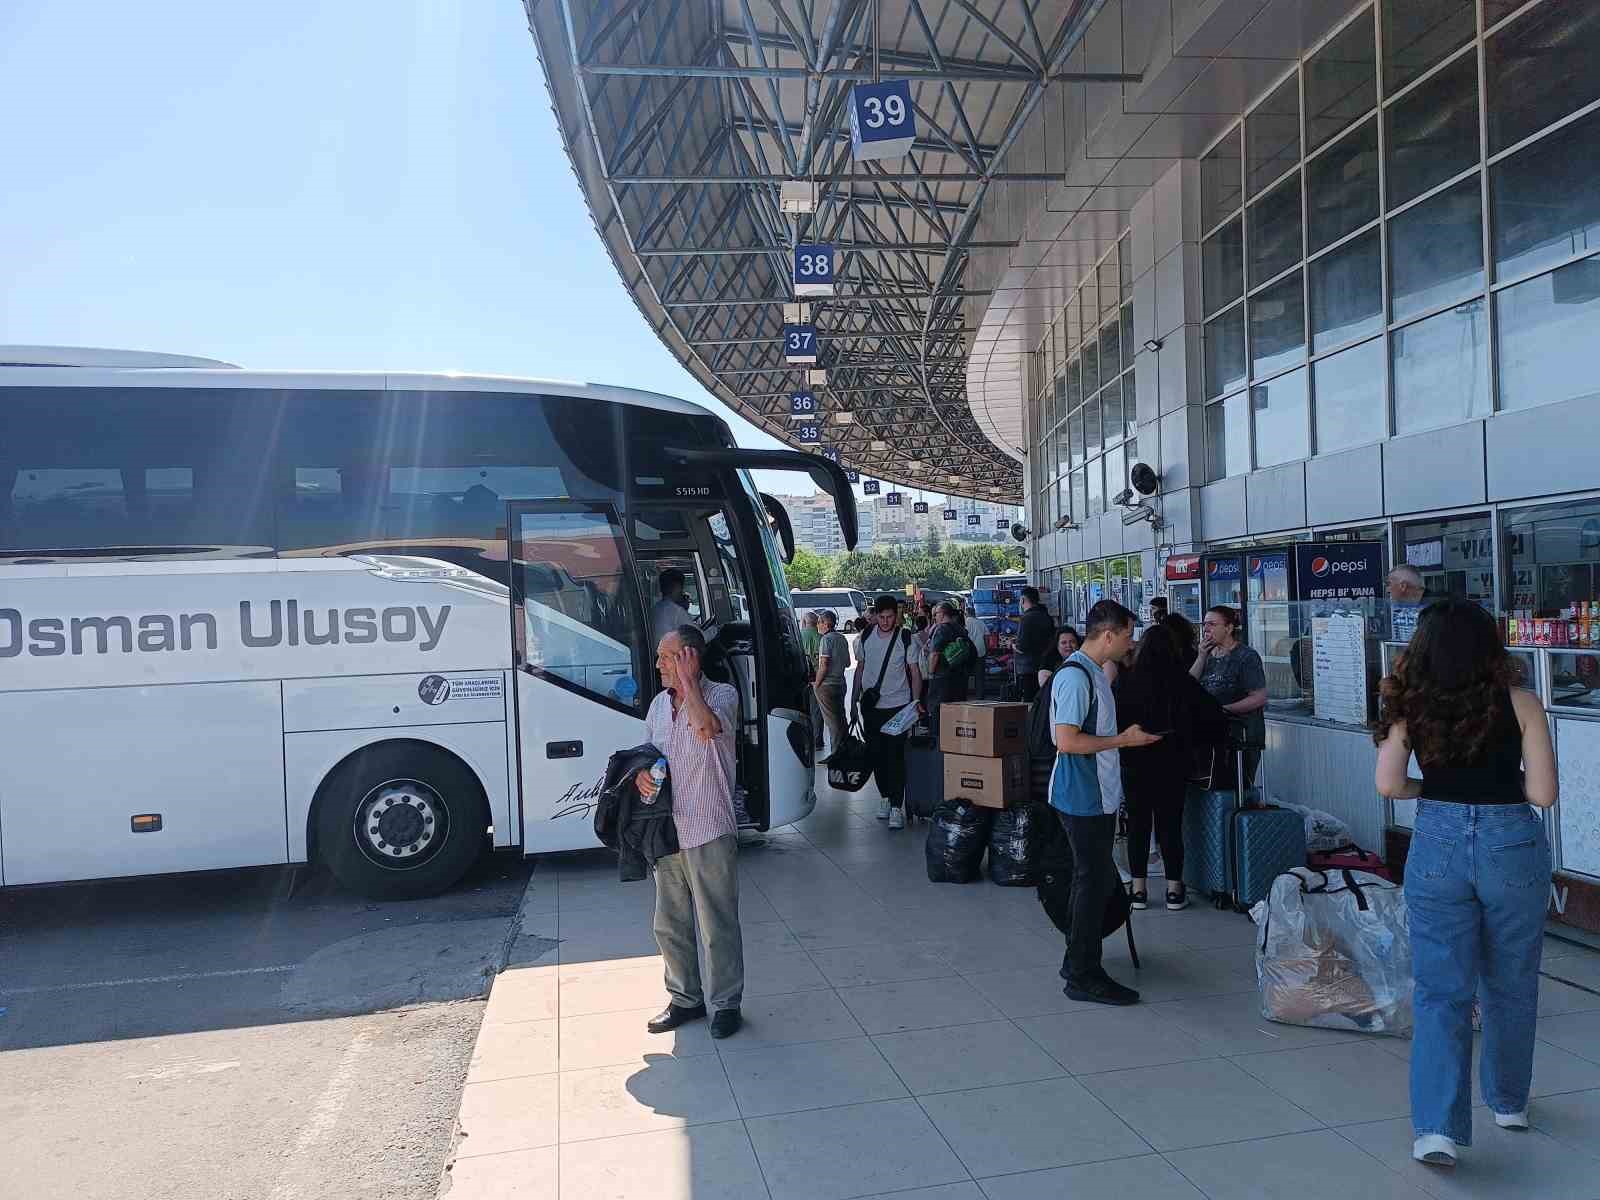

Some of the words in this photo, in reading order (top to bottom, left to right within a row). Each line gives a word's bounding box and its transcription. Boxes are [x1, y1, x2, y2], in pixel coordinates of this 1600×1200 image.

[863, 94, 906, 129] 39
[799, 254, 829, 276] 38
[789, 332, 812, 349] 37
[793, 397, 811, 410] 36
[801, 427, 817, 439] 35
[1331, 558, 1368, 575] pepsi
[239, 599, 451, 651] Ulusoy
